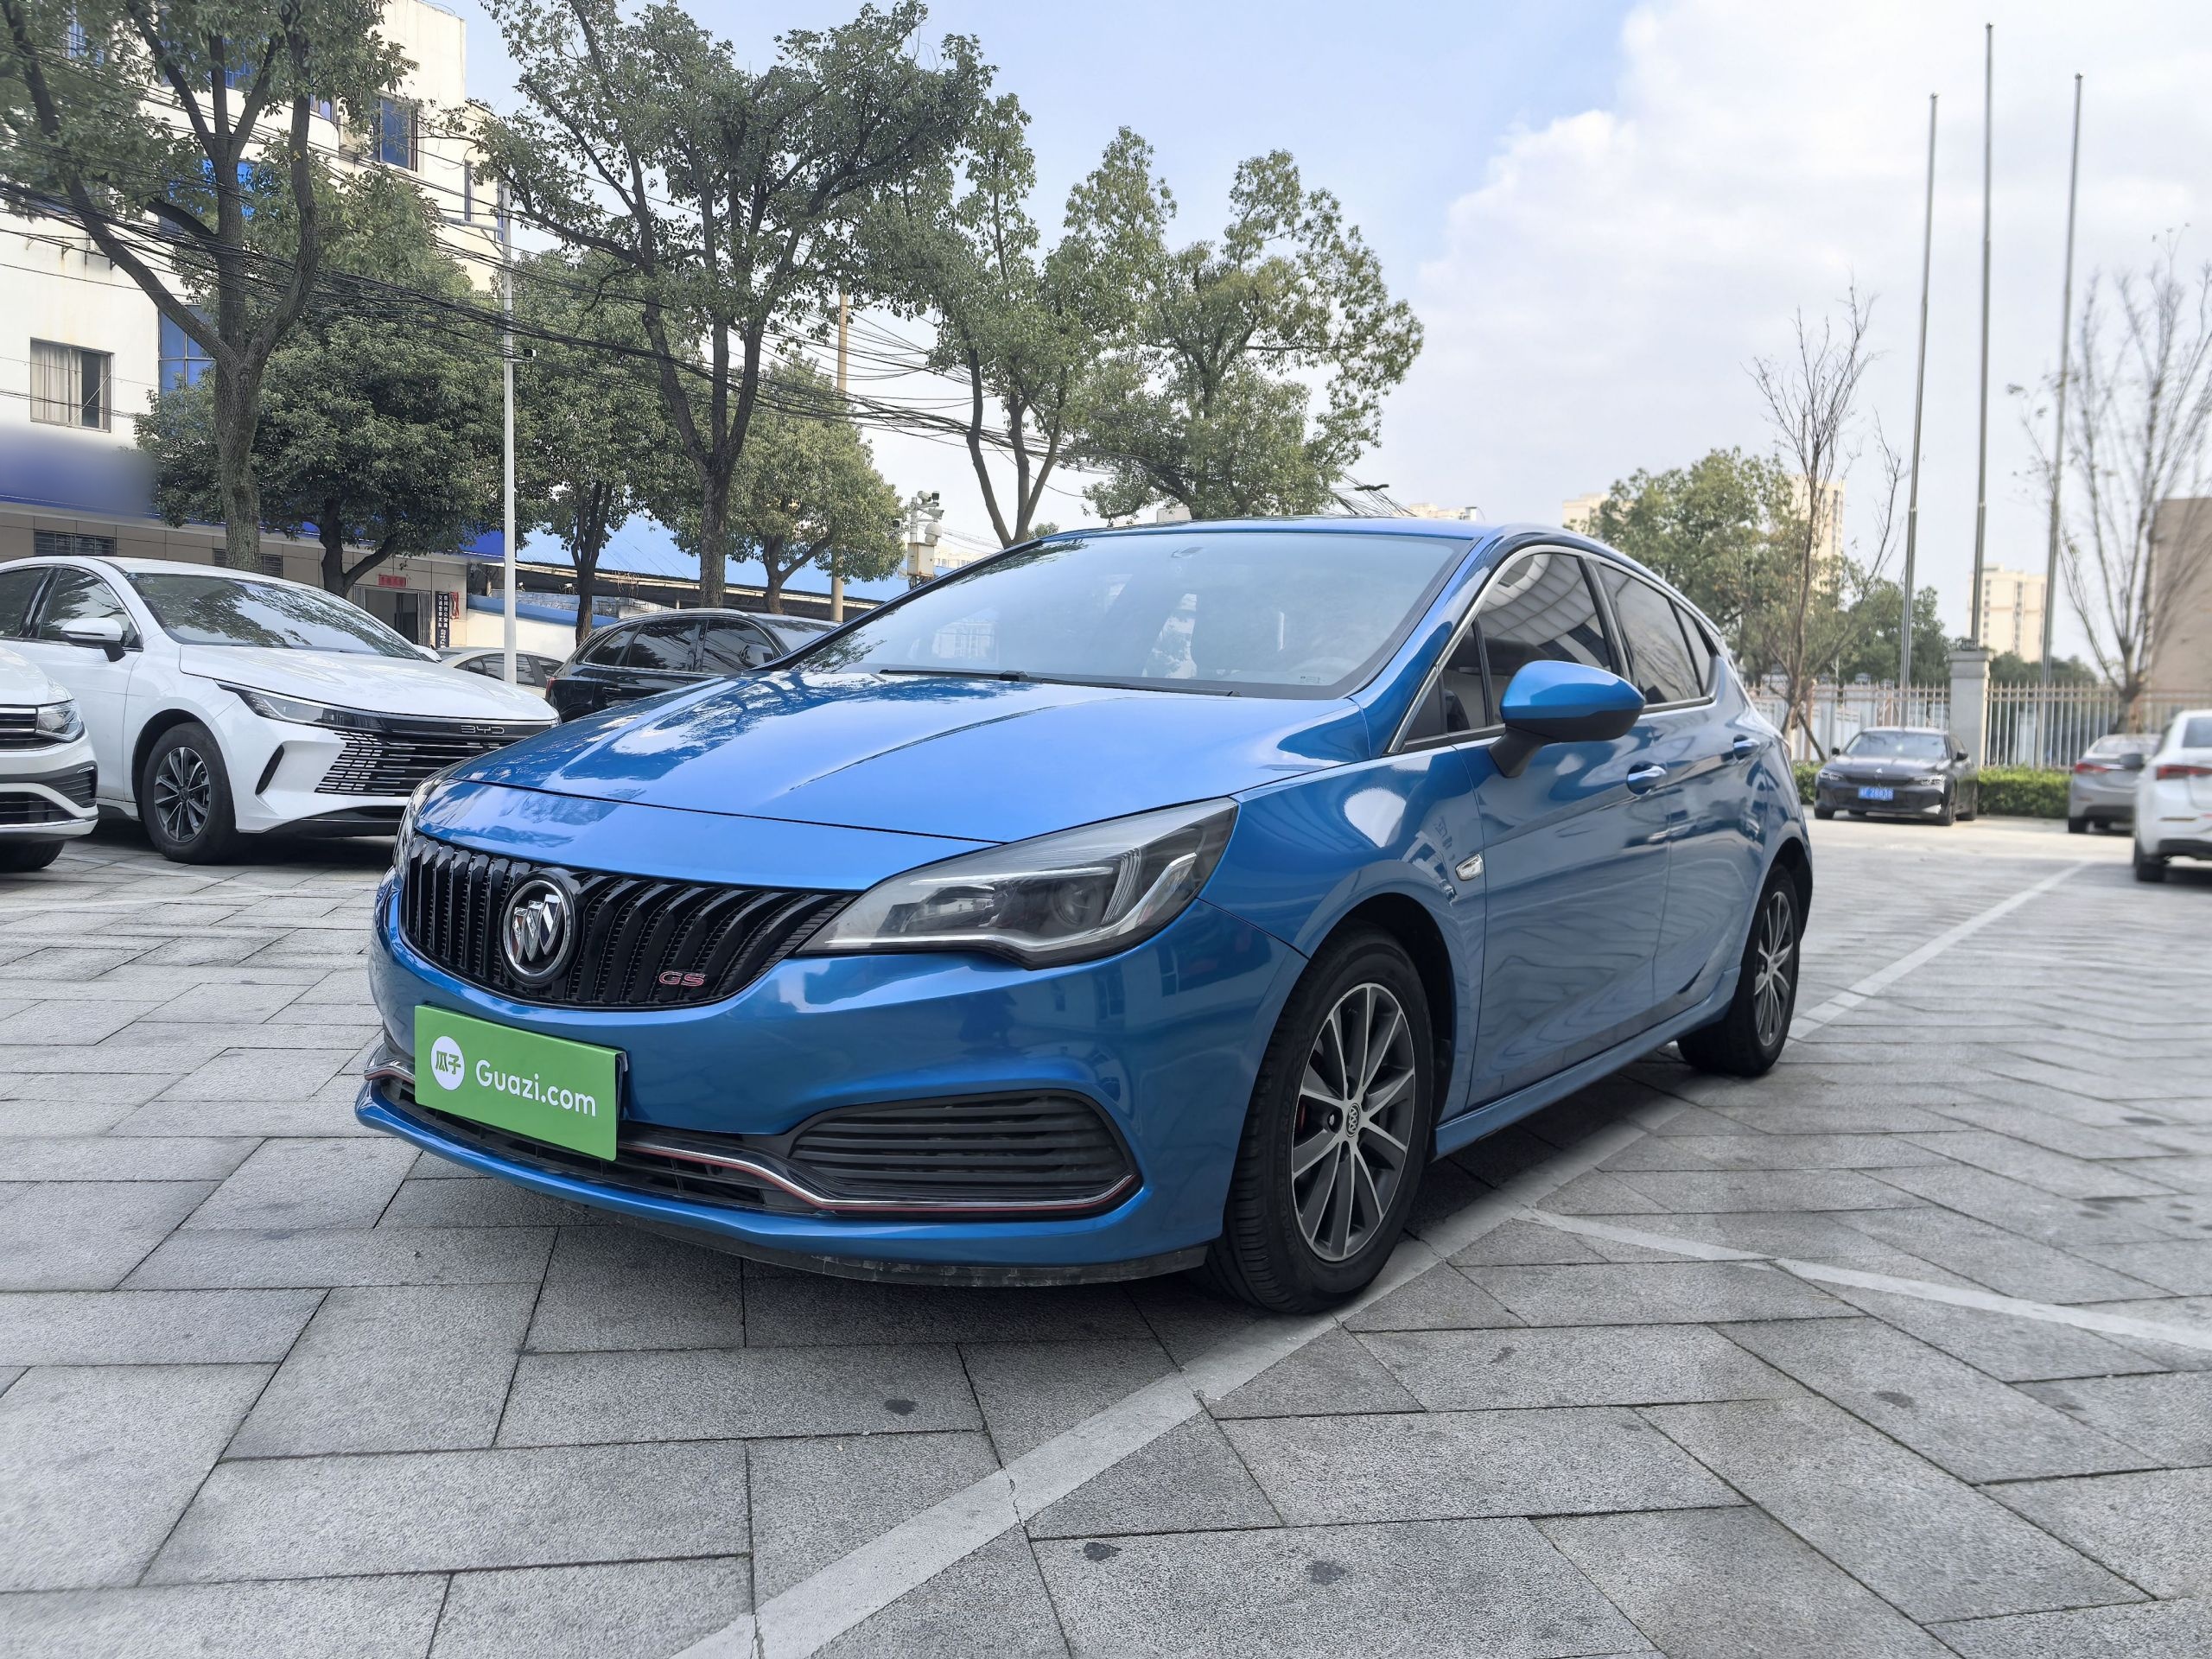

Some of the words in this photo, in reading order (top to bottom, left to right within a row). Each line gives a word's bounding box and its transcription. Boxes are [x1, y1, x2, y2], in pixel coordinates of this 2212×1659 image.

[461, 725, 505, 734] BYD
[659, 970, 705, 986] GS
[435, 1050, 461, 1075] 瓜子
[475, 1059, 596, 1117] Guazi.com
